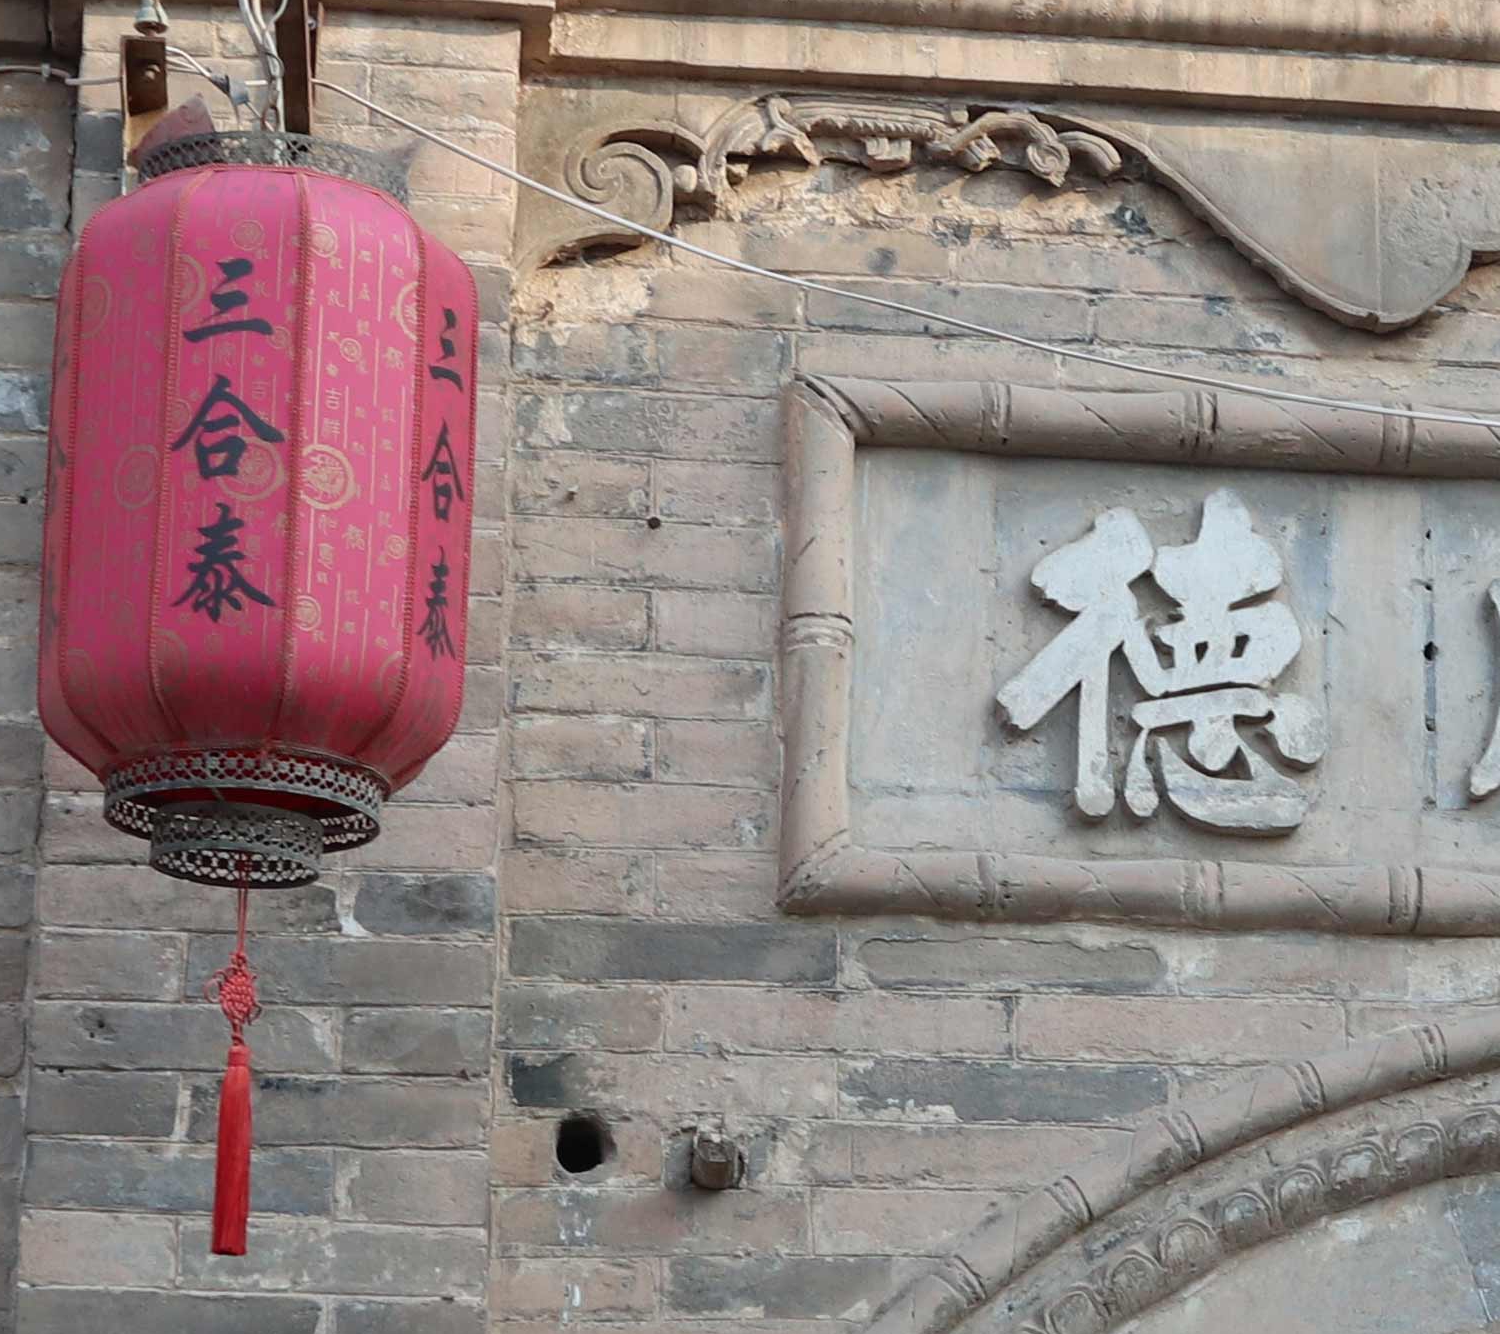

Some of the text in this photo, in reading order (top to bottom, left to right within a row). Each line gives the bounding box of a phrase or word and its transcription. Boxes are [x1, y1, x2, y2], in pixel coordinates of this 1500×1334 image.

[172, 258, 284, 624] 三合泰
[417, 306, 464, 662] 三合泰
